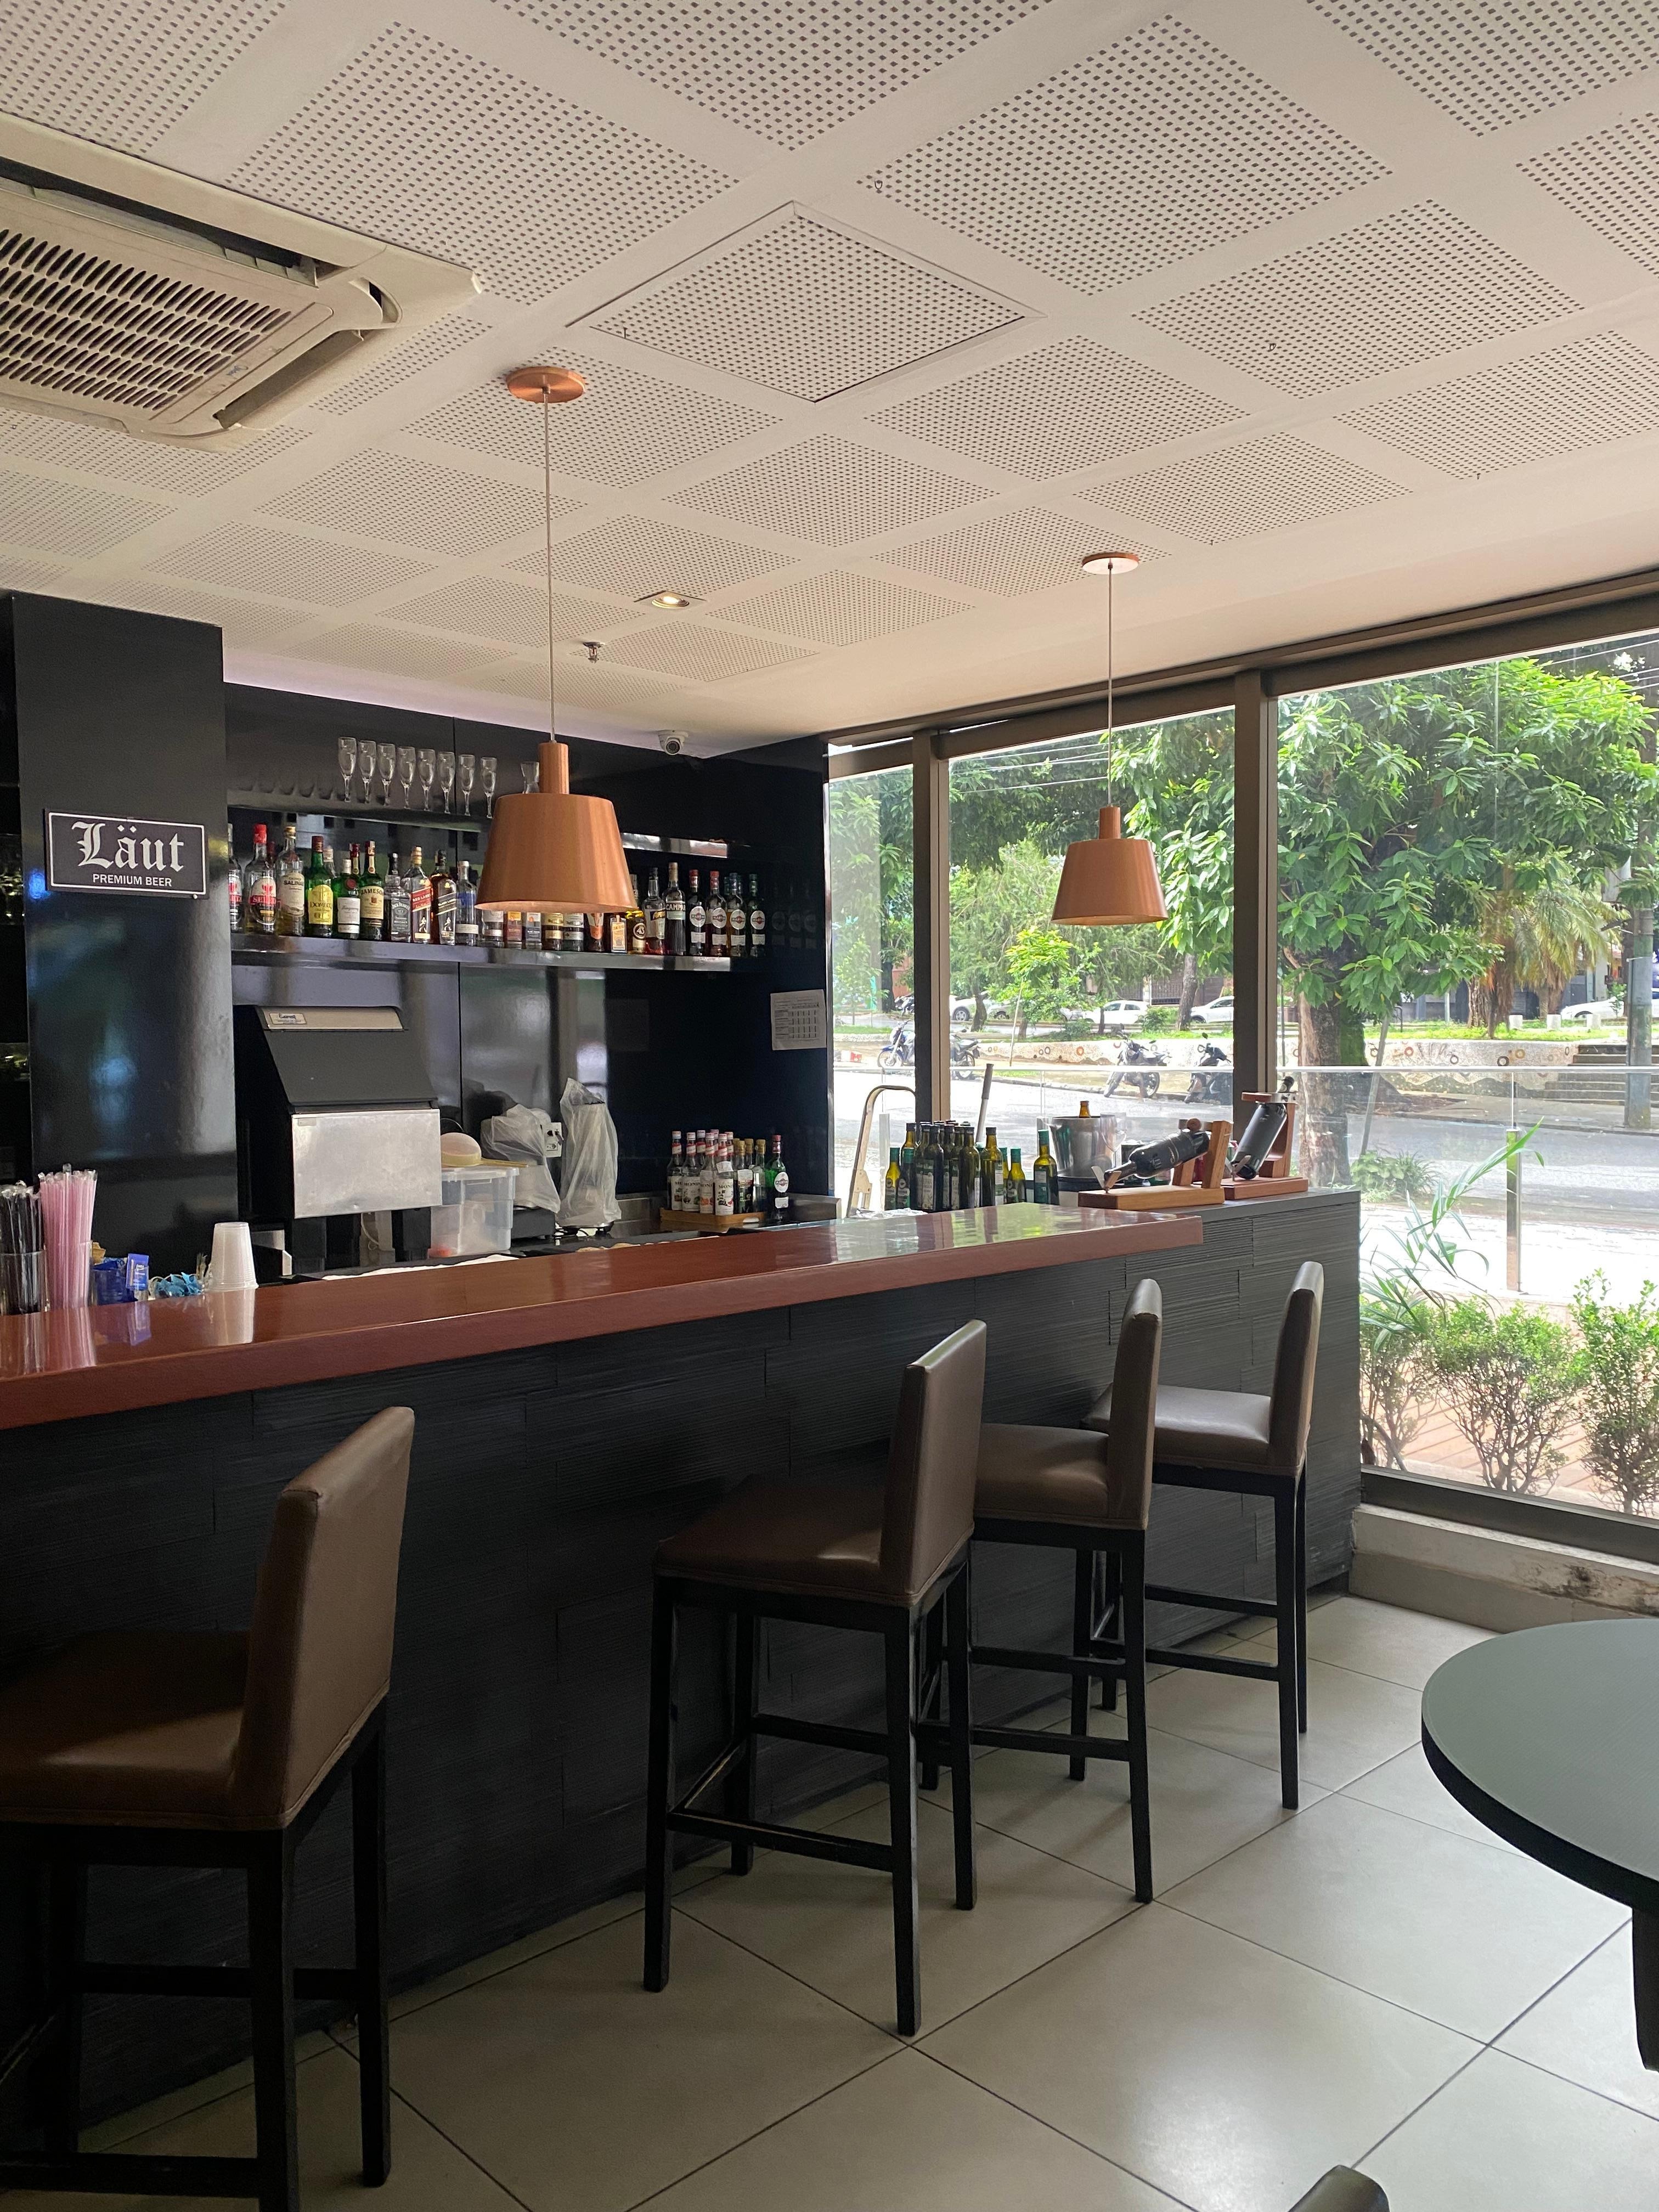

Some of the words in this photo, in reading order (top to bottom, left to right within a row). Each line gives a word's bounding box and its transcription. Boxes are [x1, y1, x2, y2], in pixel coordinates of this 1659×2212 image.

[72, 821, 184, 872] Läut
[93, 873, 142, 885] PREMIUM
[145, 877, 172, 887] BEER
